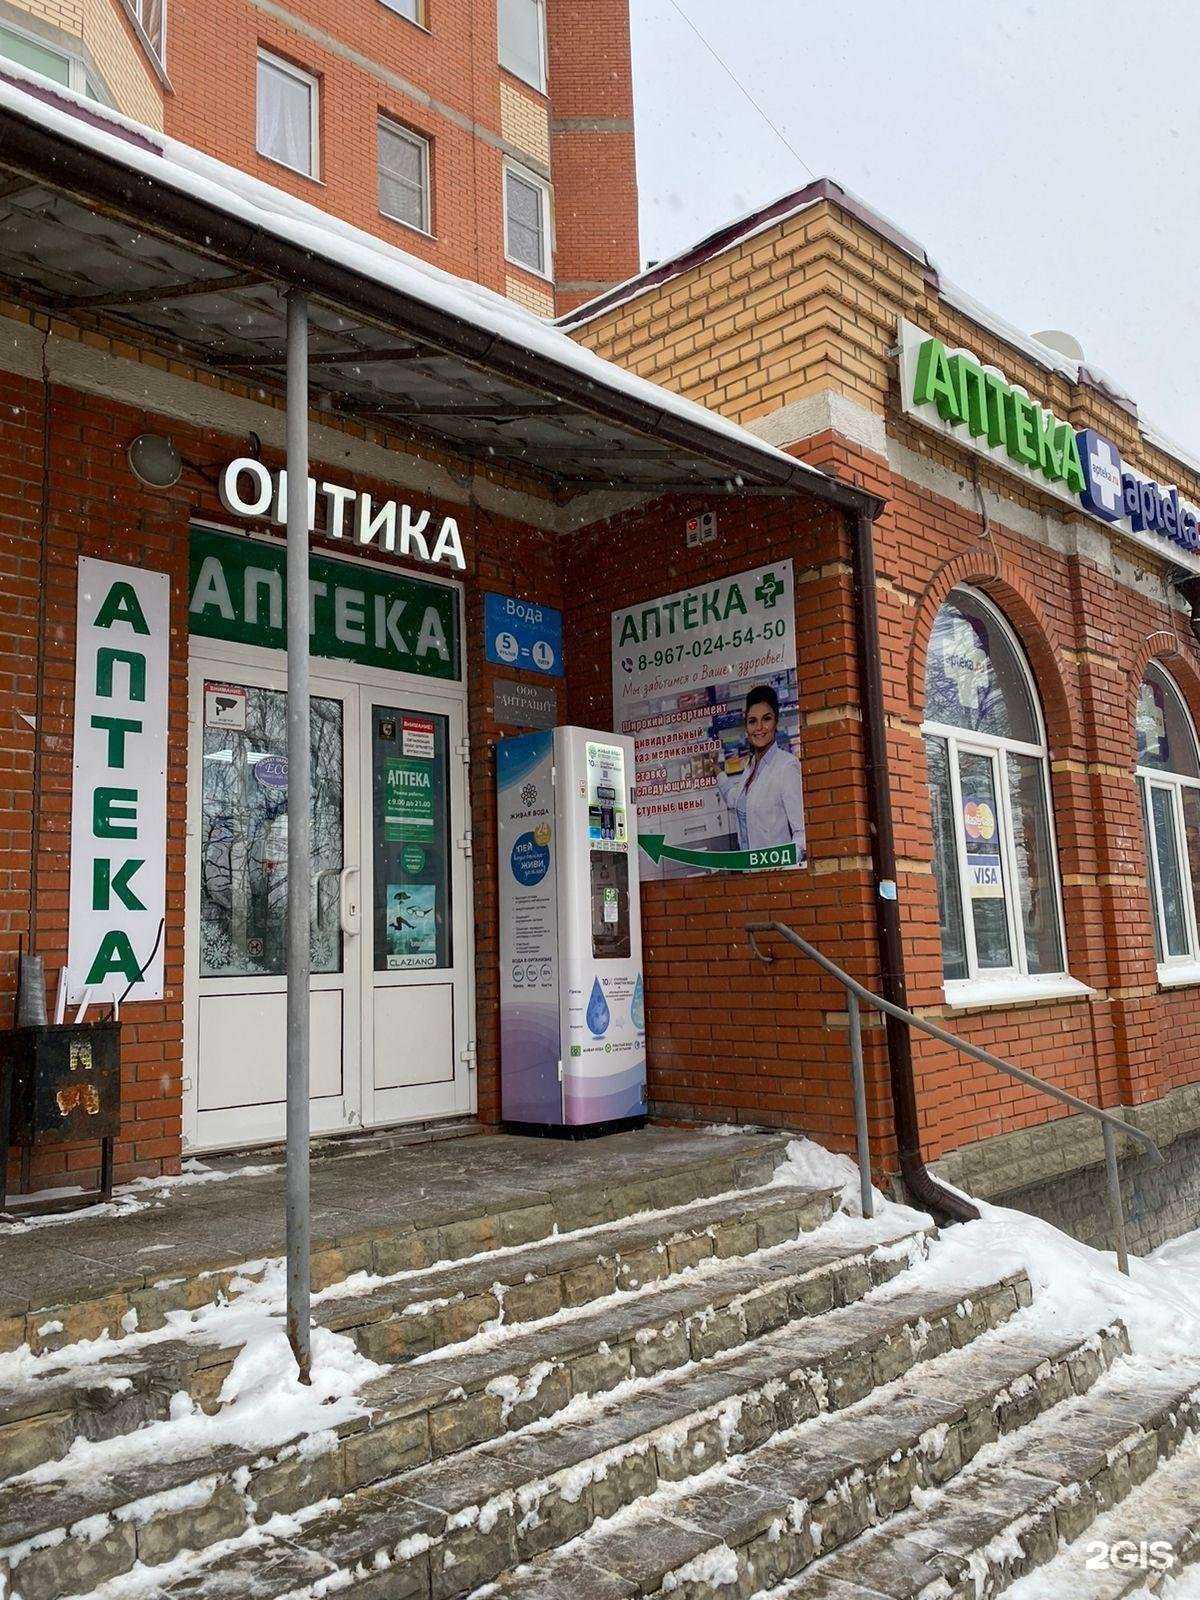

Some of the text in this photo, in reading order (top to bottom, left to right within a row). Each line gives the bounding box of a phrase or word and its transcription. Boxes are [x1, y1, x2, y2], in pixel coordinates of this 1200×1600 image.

[913, 338, 1086, 494] АПТЕКА
[220, 457, 466, 570] ОПТИКА
[506, 599, 543, 624] Вода
[619, 583, 748, 648] АПТЕКА
[502, 634, 511, 649] 5
[538, 643, 546, 659] 1
[638, 619, 786, 671] 8-967-024-54-50
[701, 664, 734, 681] Ваше
[516, 685, 538, 697] ООО
[621, 703, 728, 732] Широкий ассортимент
[634, 727, 704, 750] дивидуальный
[651, 740, 721, 760] медикаментов
[84, 581, 150, 985] АПТЕКА
[387, 769, 430, 788] АПТЕКА
[635, 768, 667, 783] ставка
[636, 775, 719, 798] следующий день
[533, 808, 549, 817] ВОДА
[636, 799, 704, 817] ступные цены
[749, 849, 791, 866] ВХОД
[974, 867, 998, 884] VISA
[389, 957, 435, 967] CLAZIANO
